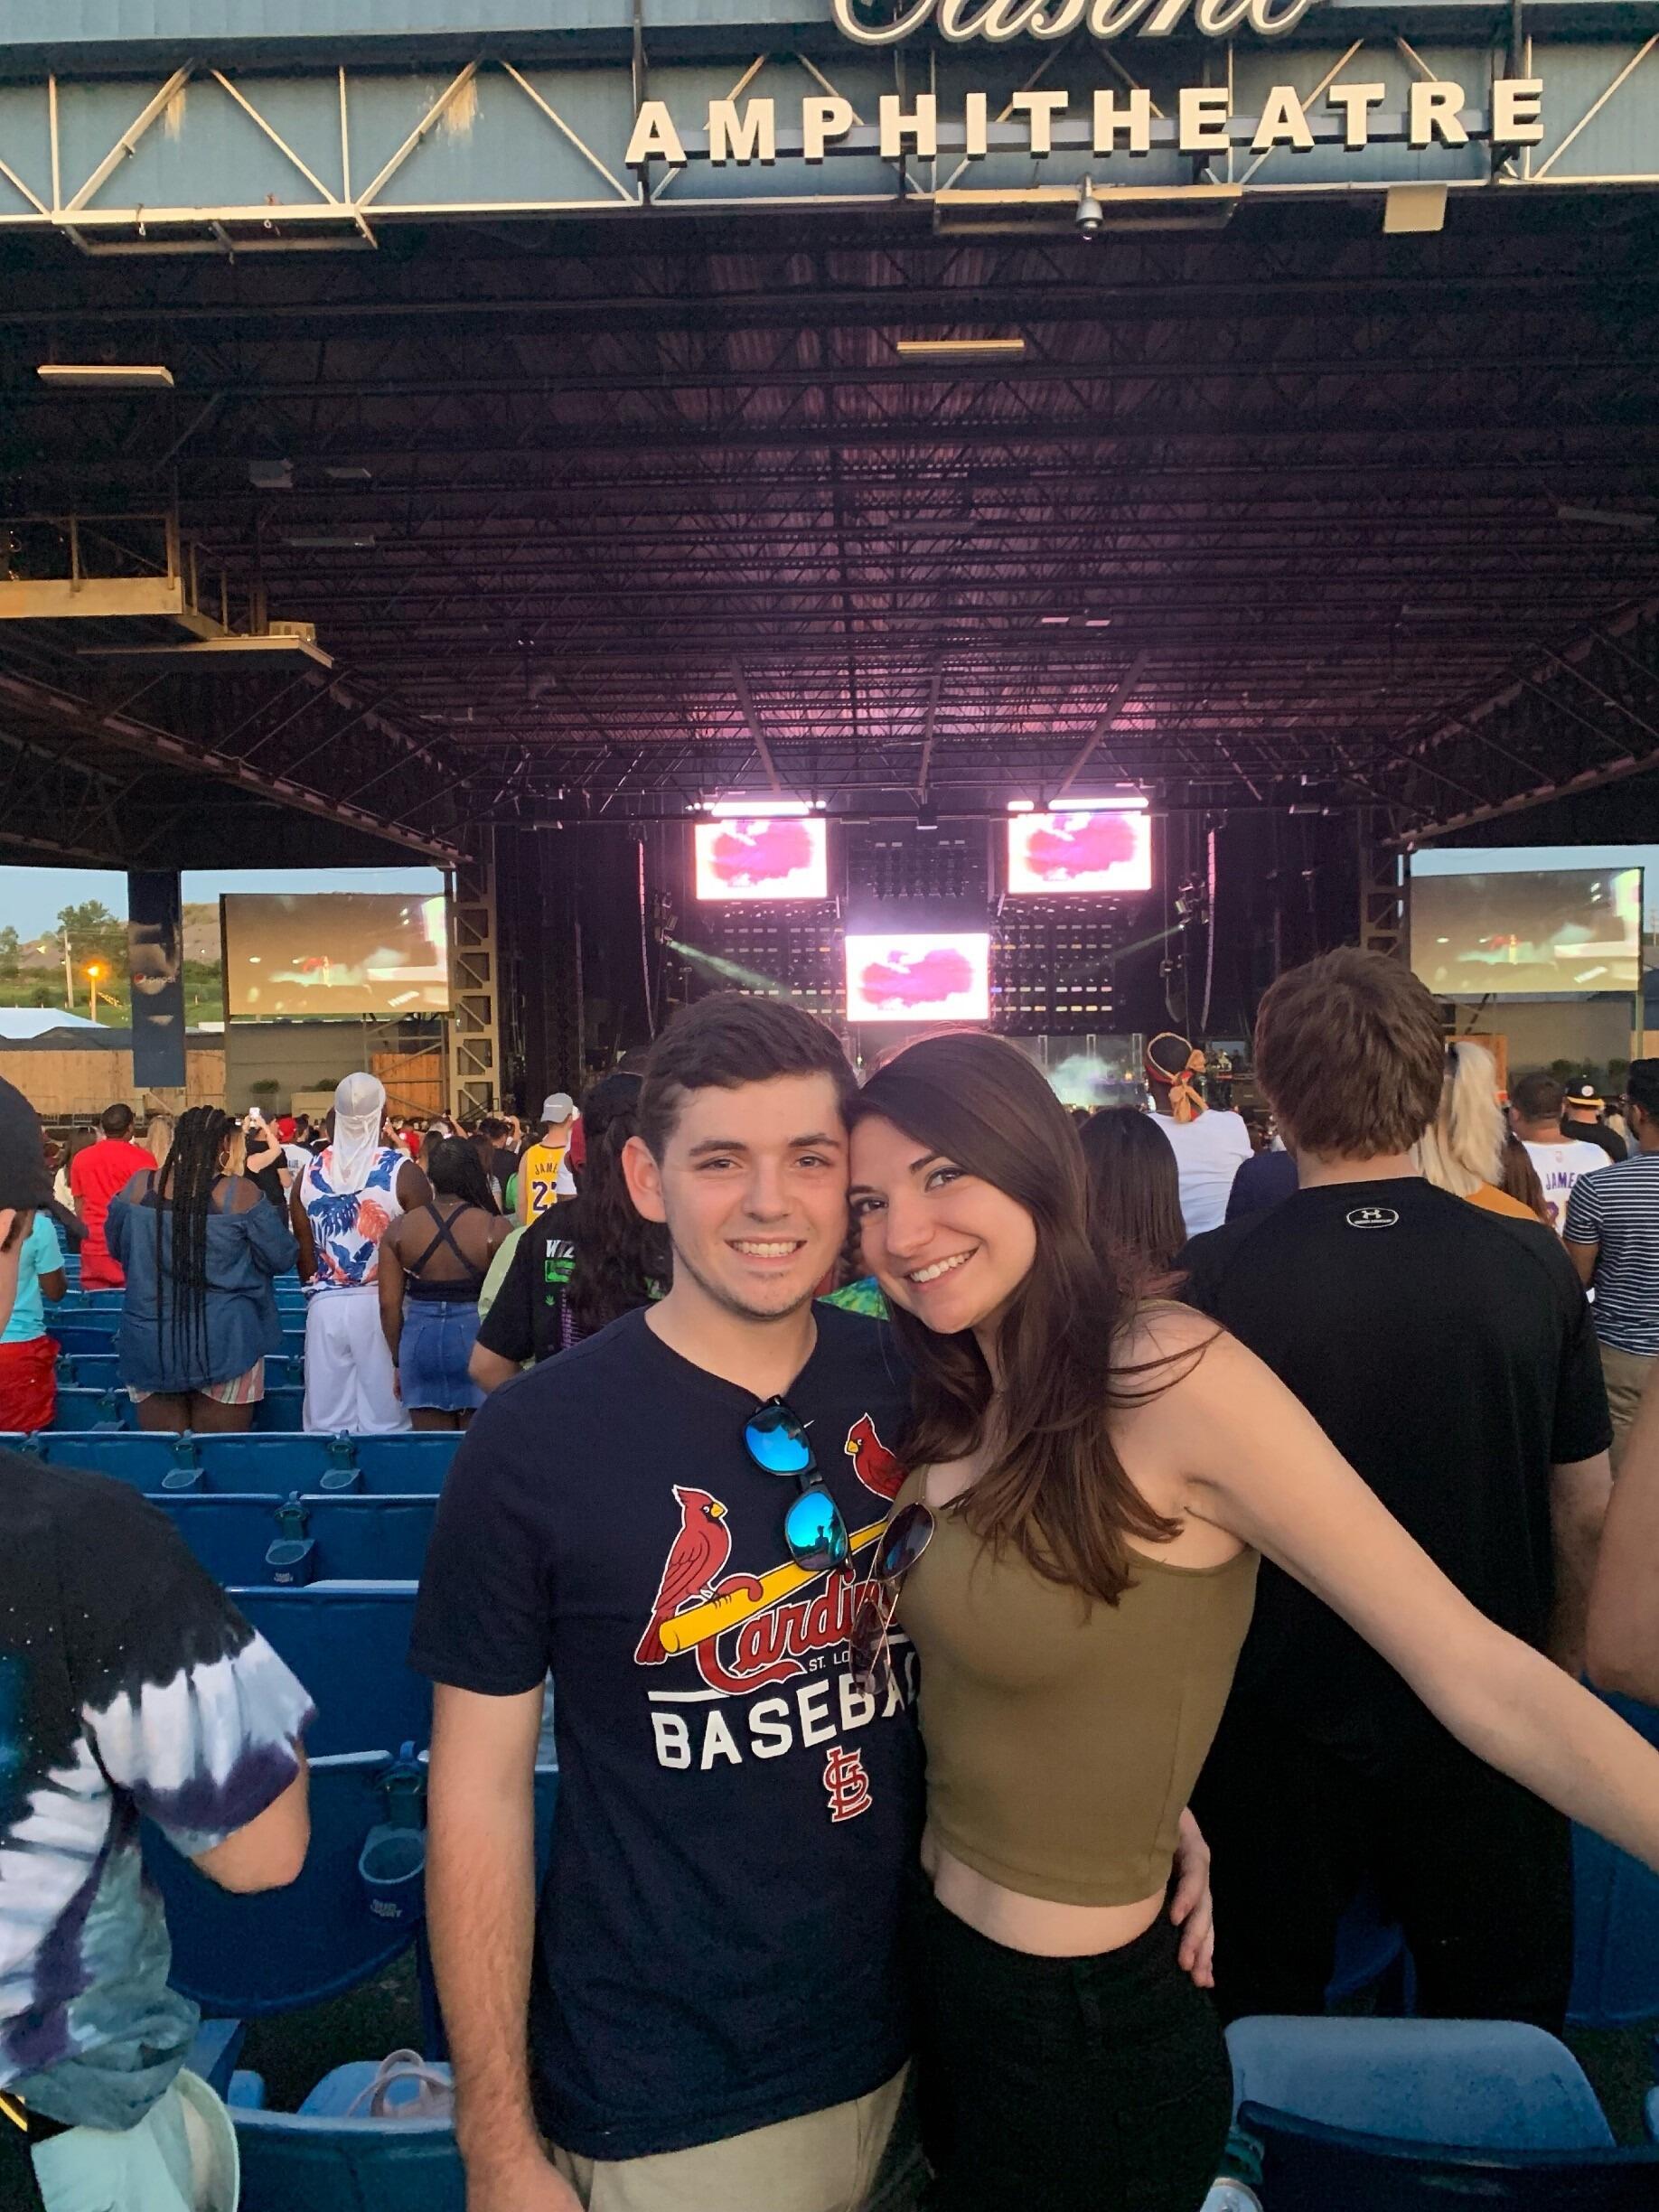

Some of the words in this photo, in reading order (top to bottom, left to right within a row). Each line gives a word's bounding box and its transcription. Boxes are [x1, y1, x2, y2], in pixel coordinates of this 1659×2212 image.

[624, 78, 1544, 167] AMPHITHEATRE
[535, 1161, 558, 1176] JAME
[1545, 1171, 1576, 1191] JAME
[808, 1655, 827, 1673] ST.
